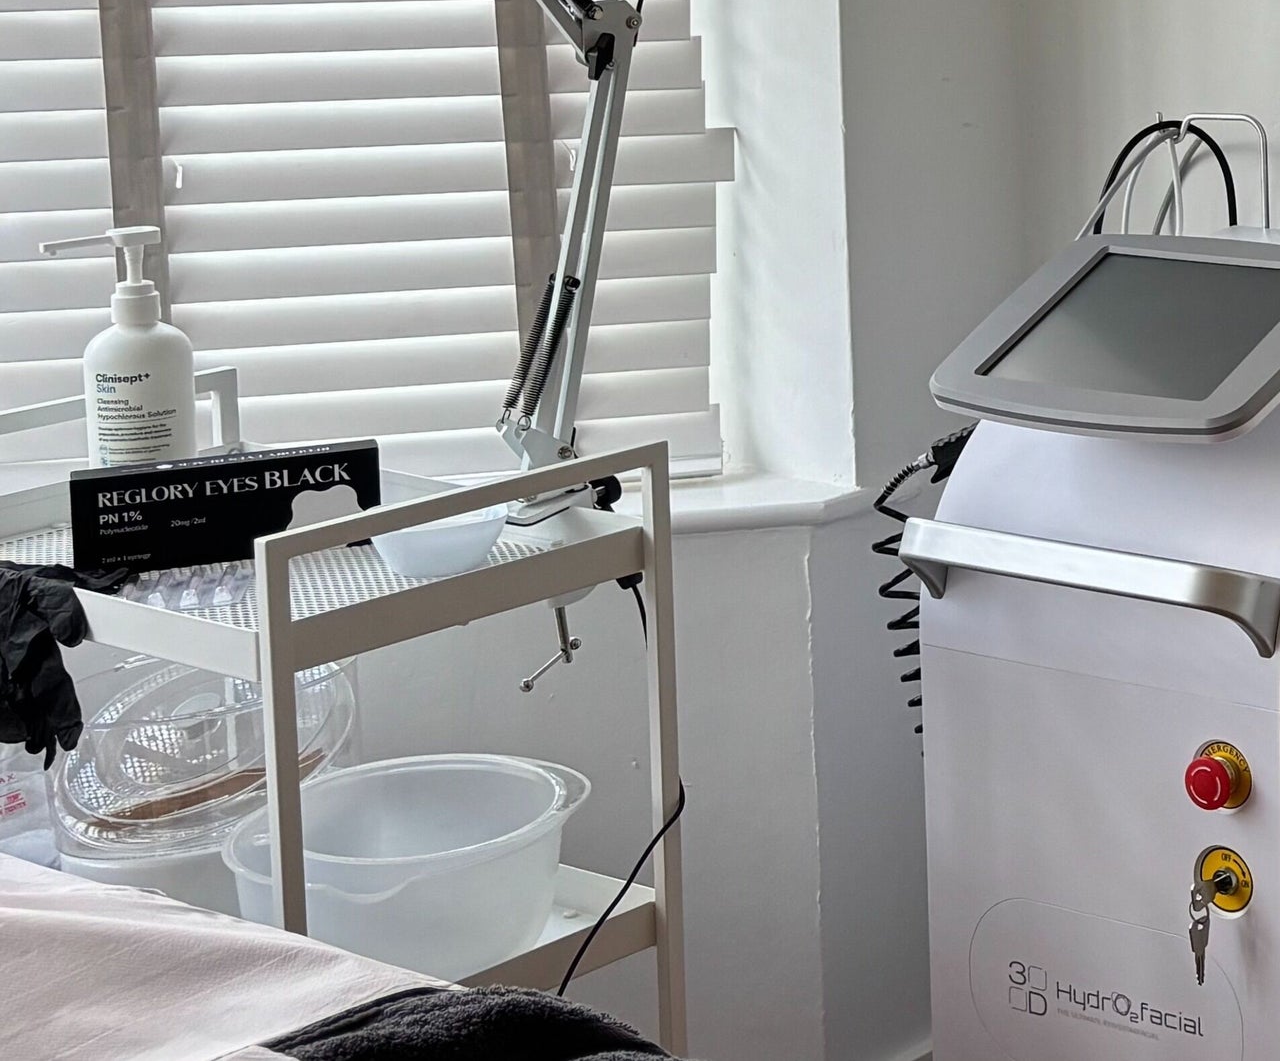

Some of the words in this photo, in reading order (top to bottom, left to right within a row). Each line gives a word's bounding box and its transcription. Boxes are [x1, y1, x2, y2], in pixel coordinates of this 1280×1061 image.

[95, 372, 151, 386] Clinisept+
[96, 383, 117, 394] Skin
[96, 404, 143, 412] Antimicrobial
[147, 408, 177, 419] Solution
[98, 481, 199, 509] REGLORY
[205, 475, 259, 497] EYES
[264, 461, 352, 490] BLACK
[99, 513, 119, 525] PN
[122, 510, 143, 523] 1%
[1205, 742, 1251, 775] MERGENCY
[1220, 852, 1233, 864] OFF
